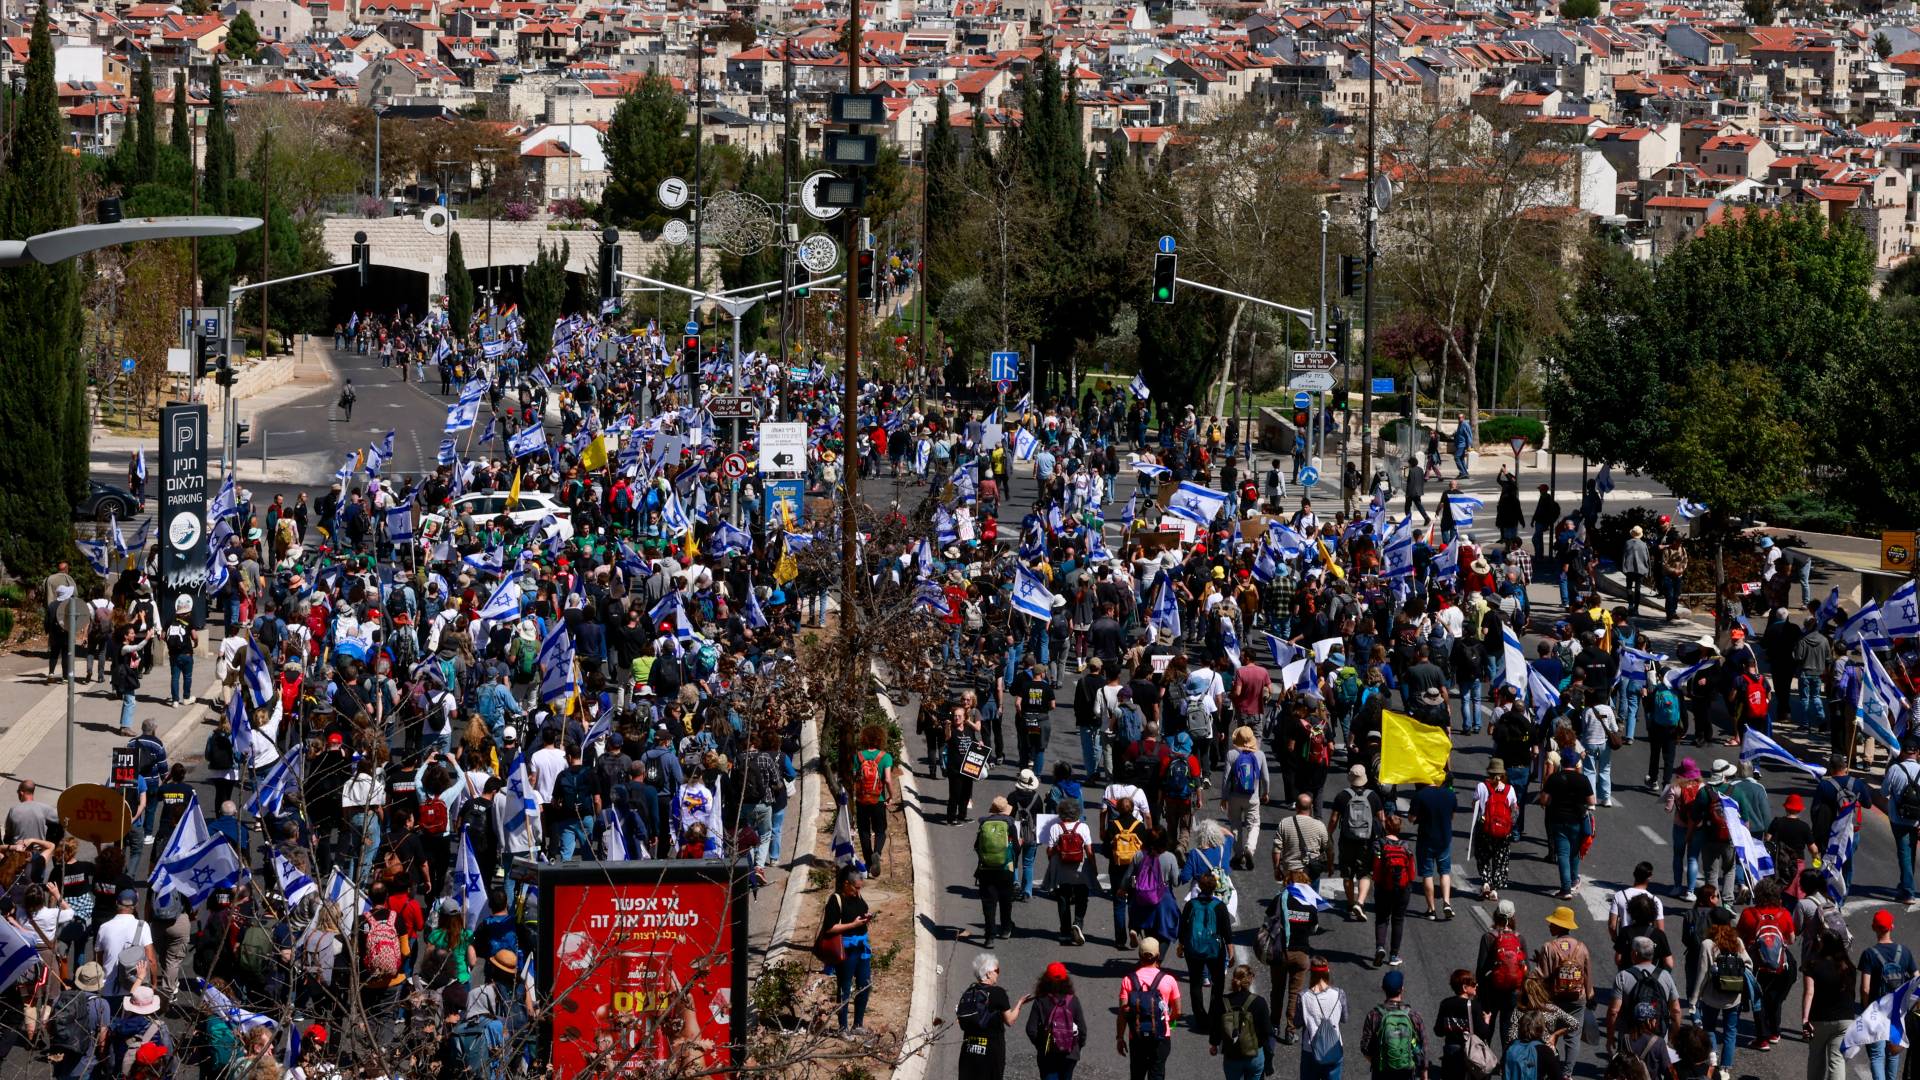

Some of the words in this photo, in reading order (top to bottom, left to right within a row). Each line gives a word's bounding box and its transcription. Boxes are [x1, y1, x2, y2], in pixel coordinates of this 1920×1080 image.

[173, 457, 197, 476] חניון
[166, 473, 204, 491] הלאום
[168, 492, 203, 506] PARKING
[610, 897, 658, 911] אפשר
[661, 897, 680, 911] אי
[590, 915, 610, 928] זה
[614, 914, 639, 928] את
[642, 910, 699, 928] לשתות
